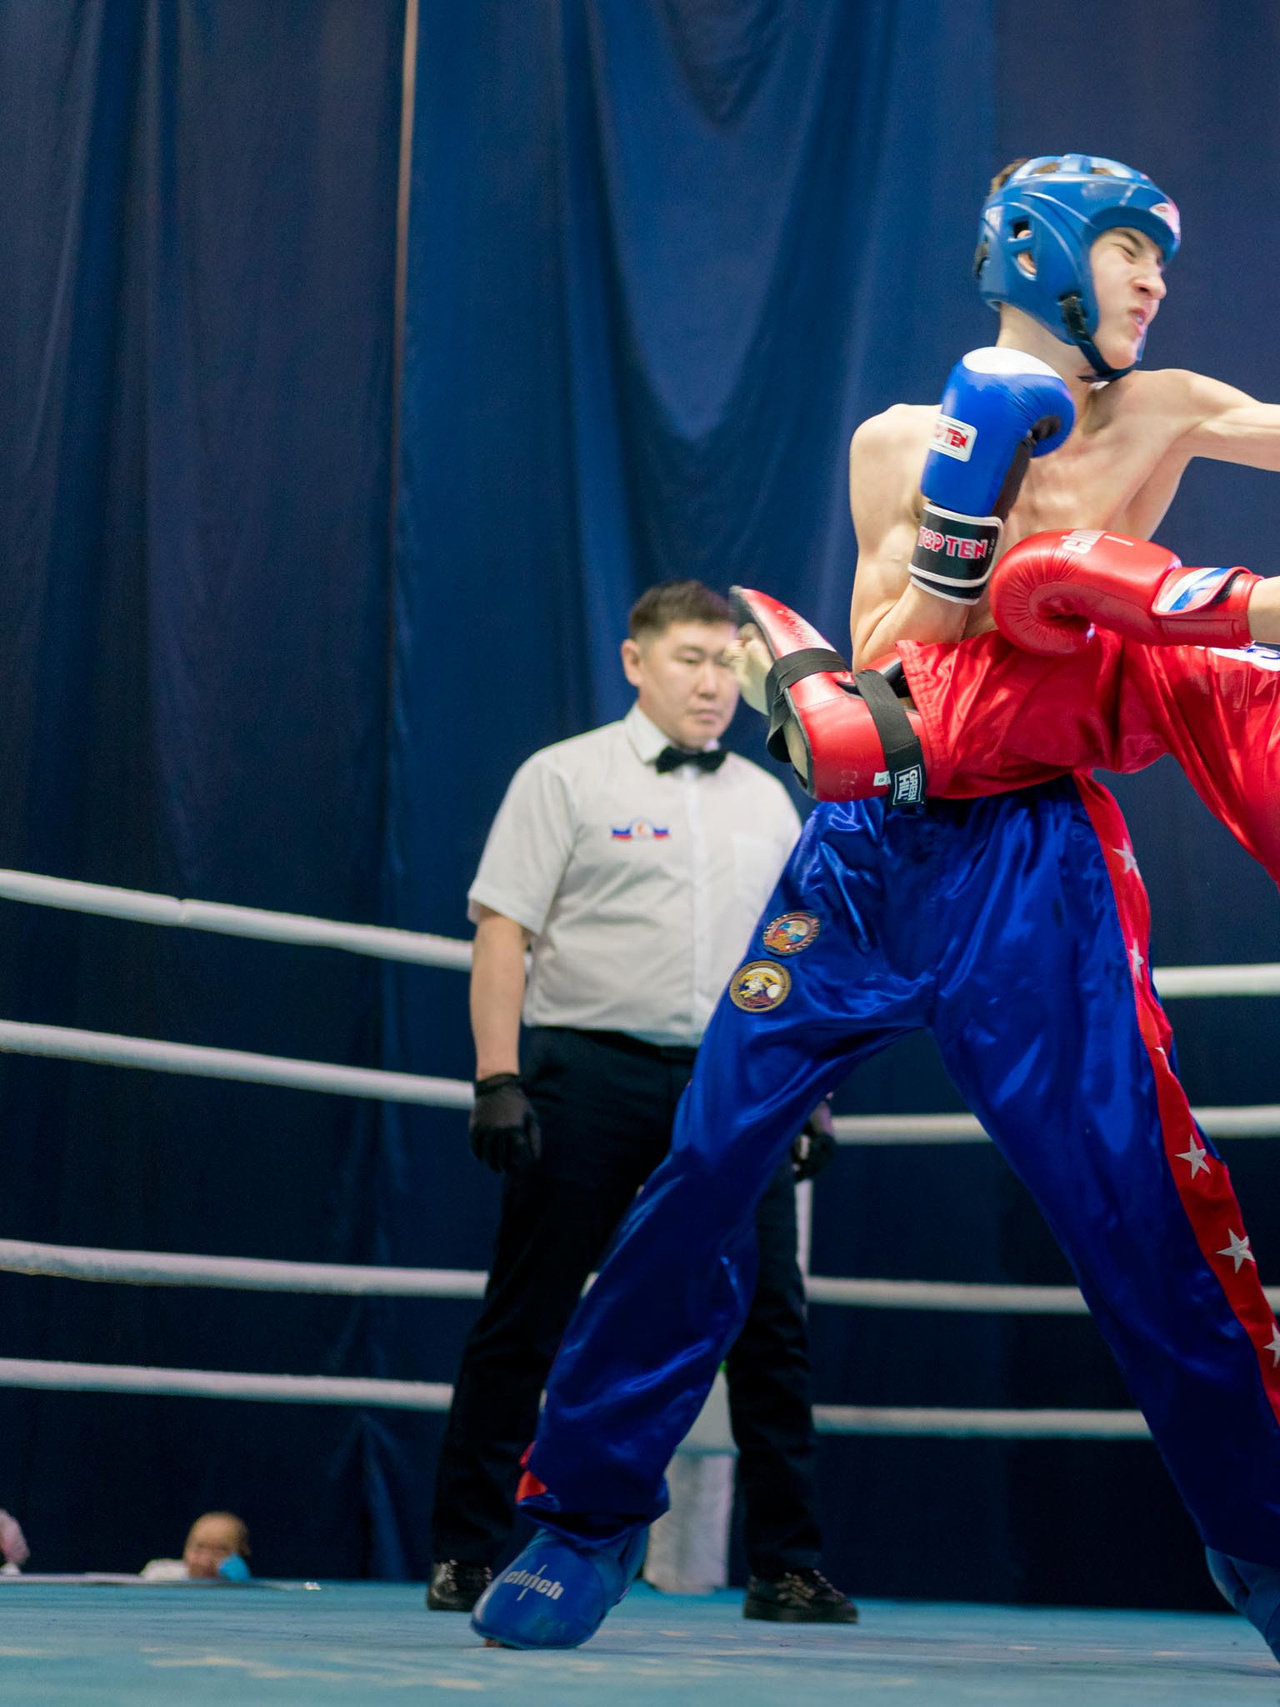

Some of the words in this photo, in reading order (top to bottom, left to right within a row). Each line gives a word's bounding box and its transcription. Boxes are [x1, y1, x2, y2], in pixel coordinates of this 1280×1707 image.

[917, 525, 945, 553] TOP
[945, 534, 988, 560] TEN
[504, 1569, 565, 1600] clinch
